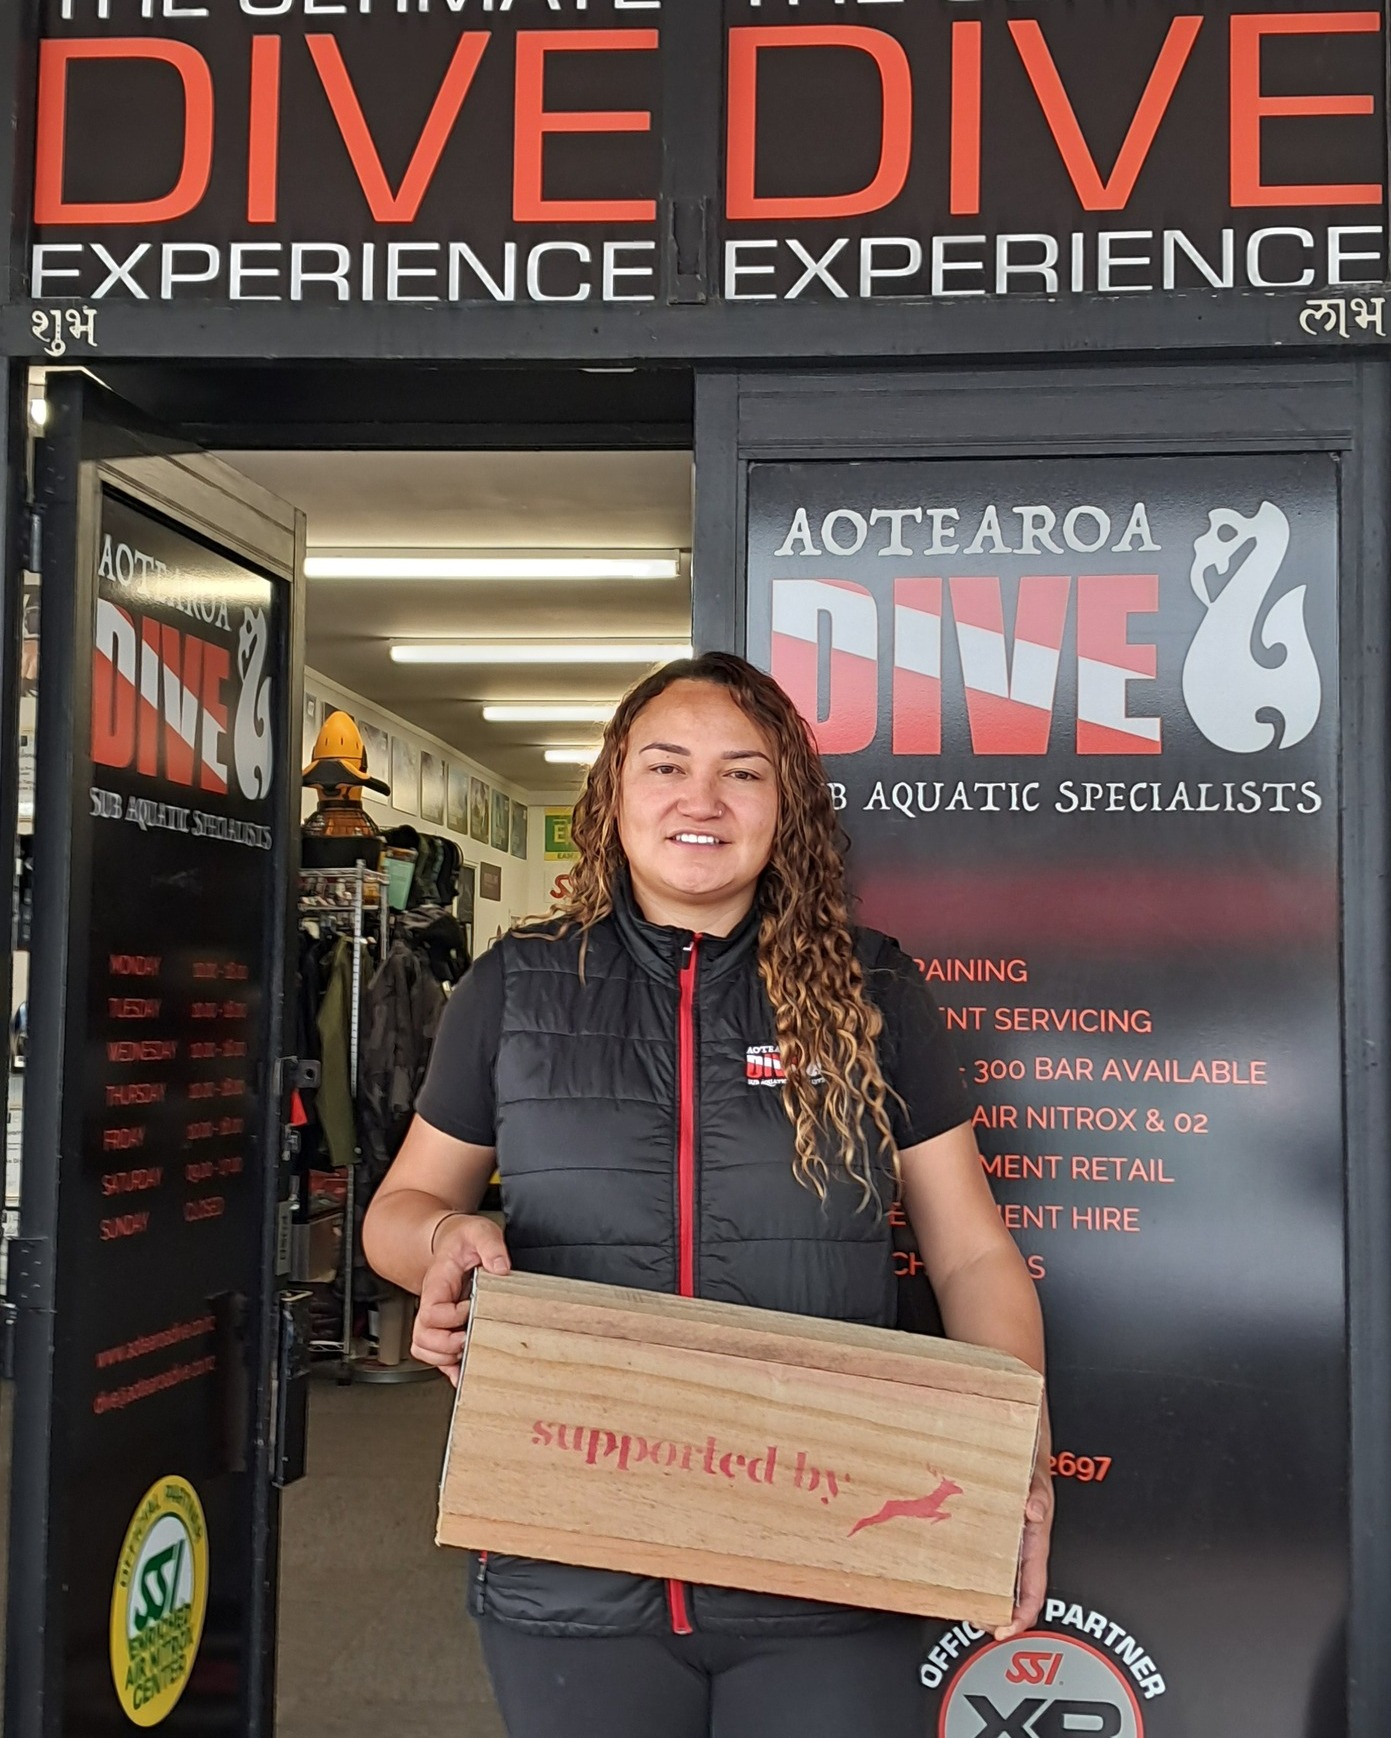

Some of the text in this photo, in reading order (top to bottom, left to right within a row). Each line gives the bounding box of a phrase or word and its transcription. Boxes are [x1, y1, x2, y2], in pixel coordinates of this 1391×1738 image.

[34, 29, 658, 224] DIVE
[726, 12, 1382, 220] DIVE
[30, 240, 656, 301] EXPERIENCE
[724, 225, 1383, 300] EXPERIENCE
[774, 502, 1162, 557] AOTEAROA
[98, 534, 232, 632] AOTEROA
[770, 574, 1163, 756] DIVE
[91, 598, 230, 795] DIVE
[862, 781, 1039, 818] AQUATIC
[1054, 781, 1322, 814] SPECIALISTS
[995, 1007, 1153, 1032] SERVICING
[974, 1057, 1268, 1085] 300 BAR AVAILABLE
[971, 1105, 1018, 1129] AIR
[1026, 1106, 1137, 1132] NITROX
[1146, 1109, 1165, 1132] &
[1072, 1156, 1175, 1183] RETAIL
[1072, 1206, 1140, 1232] HIRE
[532, 1420, 851, 1505] supported by
[1004, 1650, 1065, 1686] SSI
[1045, 1598, 1167, 1700] PARTNER
